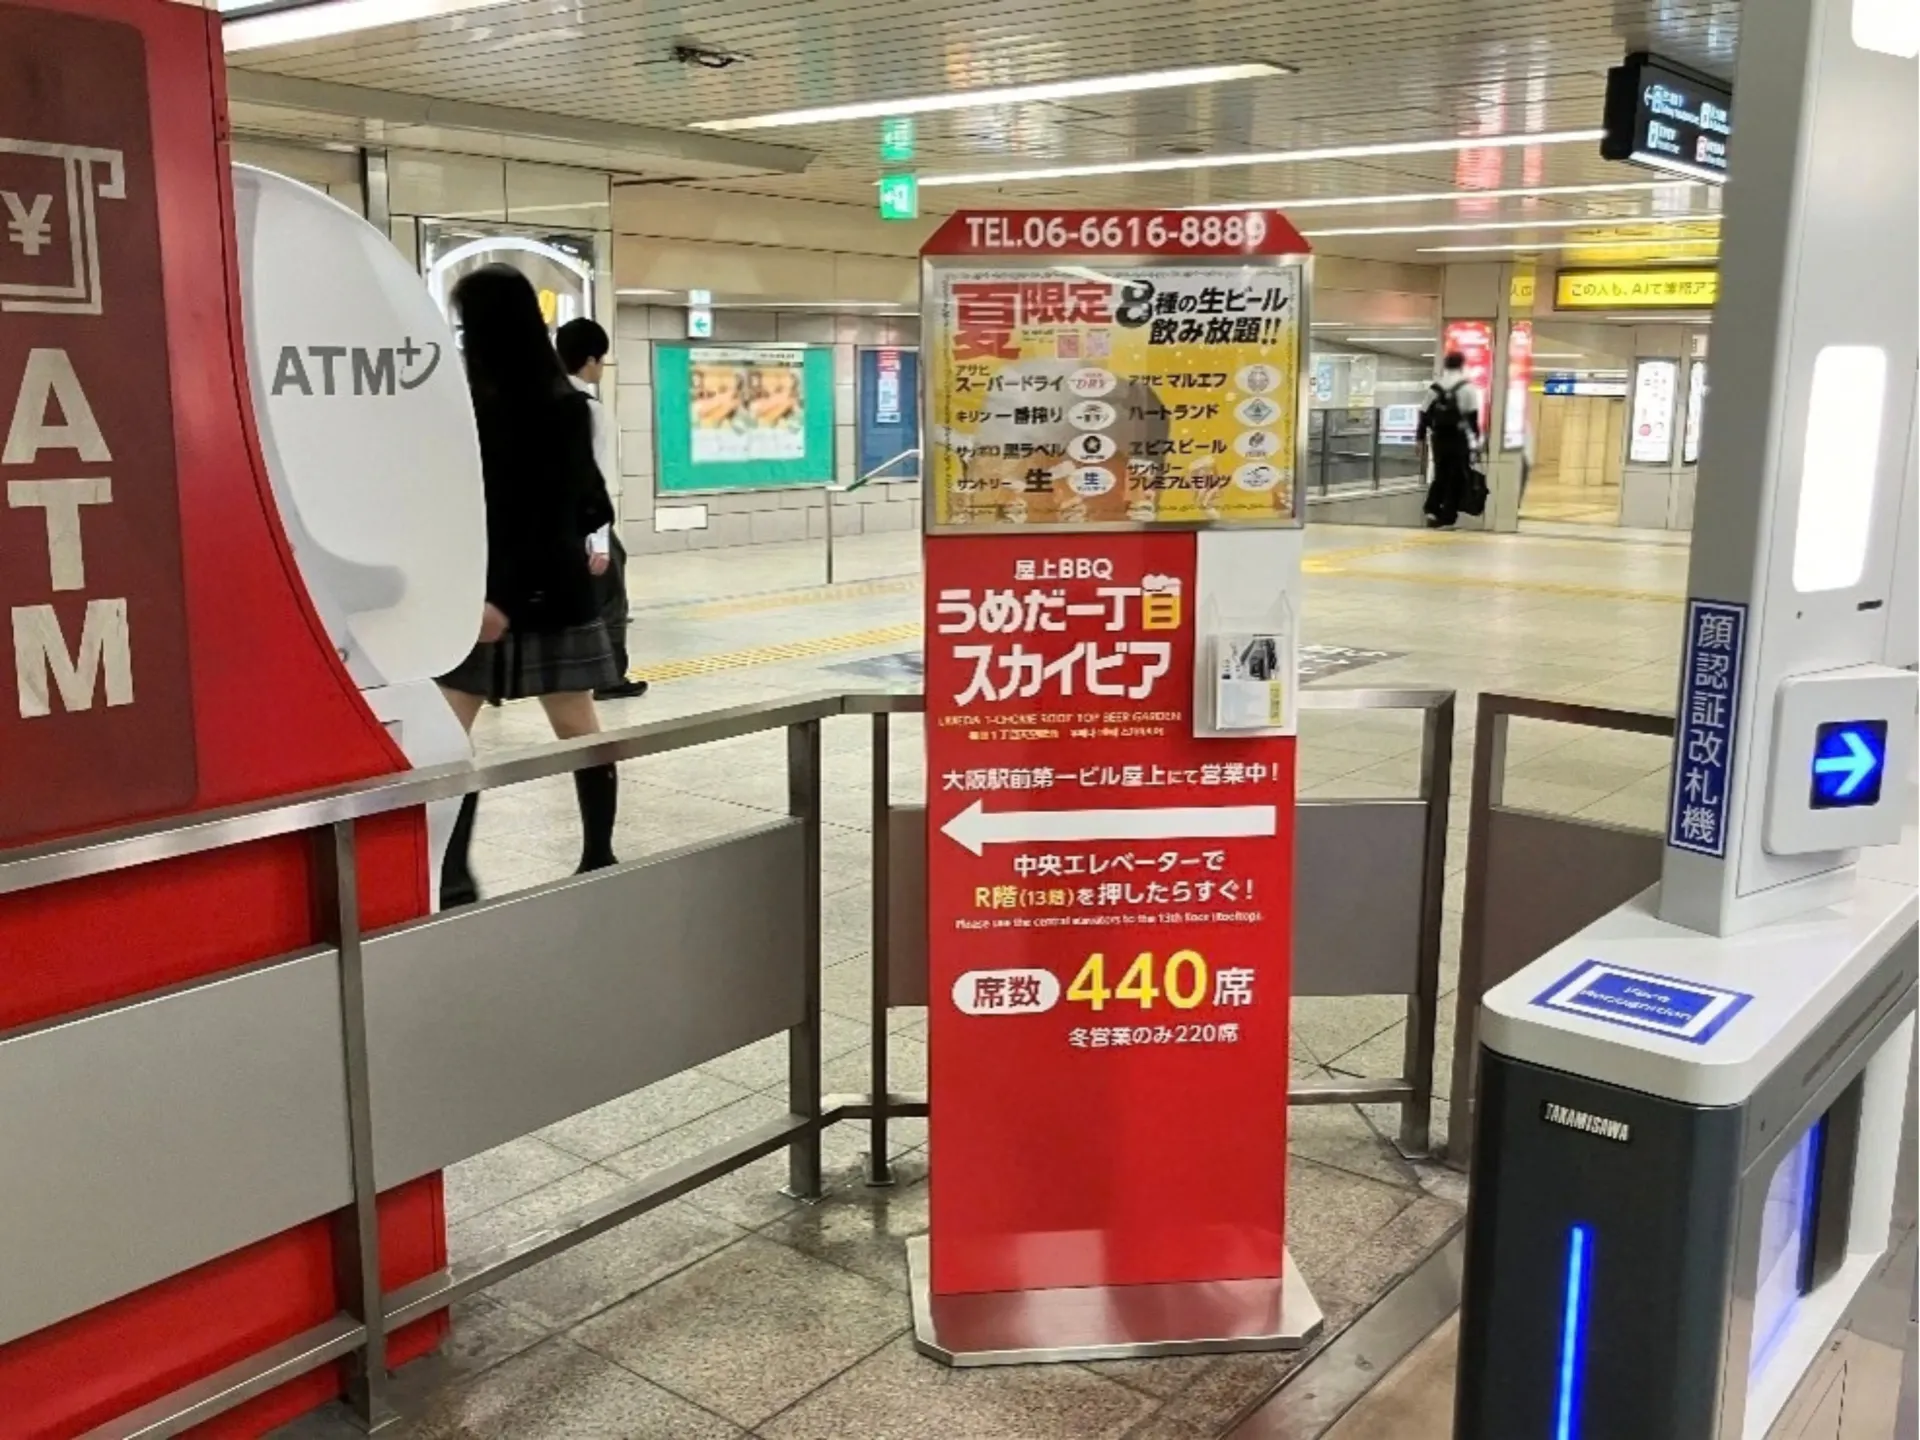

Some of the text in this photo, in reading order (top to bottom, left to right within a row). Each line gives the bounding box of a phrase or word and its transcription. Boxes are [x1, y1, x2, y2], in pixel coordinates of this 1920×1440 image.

[965, 215, 1267, 249] TEL.06-6616-8889
[952, 281, 1114, 361] 夏限定
[955, 375, 1065, 392] スーパードライ
[956, 365, 990, 376] アサヒ
[1128, 372, 1228, 389] アサヒ マルエフ
[956, 411, 992, 424] キリン
[995, 406, 1064, 425] 一番搾り
[1128, 403, 1220, 421] ハートランド
[1002, 443, 1067, 461] 黒ラベル
[956, 468, 1054, 493] サントリー 生
[1127, 463, 1184, 476] サントリー
[1128, 475, 1233, 492] プレミアムモルツ
[2, 347, 134, 719] ATM
[1014, 557, 1114, 581] 屋上BBQ
[936, 573, 1182, 634] うめだ一丁目
[953, 641, 1172, 707] スカイビア
[1680, 612, 1735, 845] 顔認証改札機
[1013, 850, 1227, 877] 中央エレベーターで
[972, 975, 1042, 1010] 席数
[1068, 1022, 1240, 1049] 冬営業のみ220席
[1544, 1102, 1630, 1142] TAKAMISAWA
